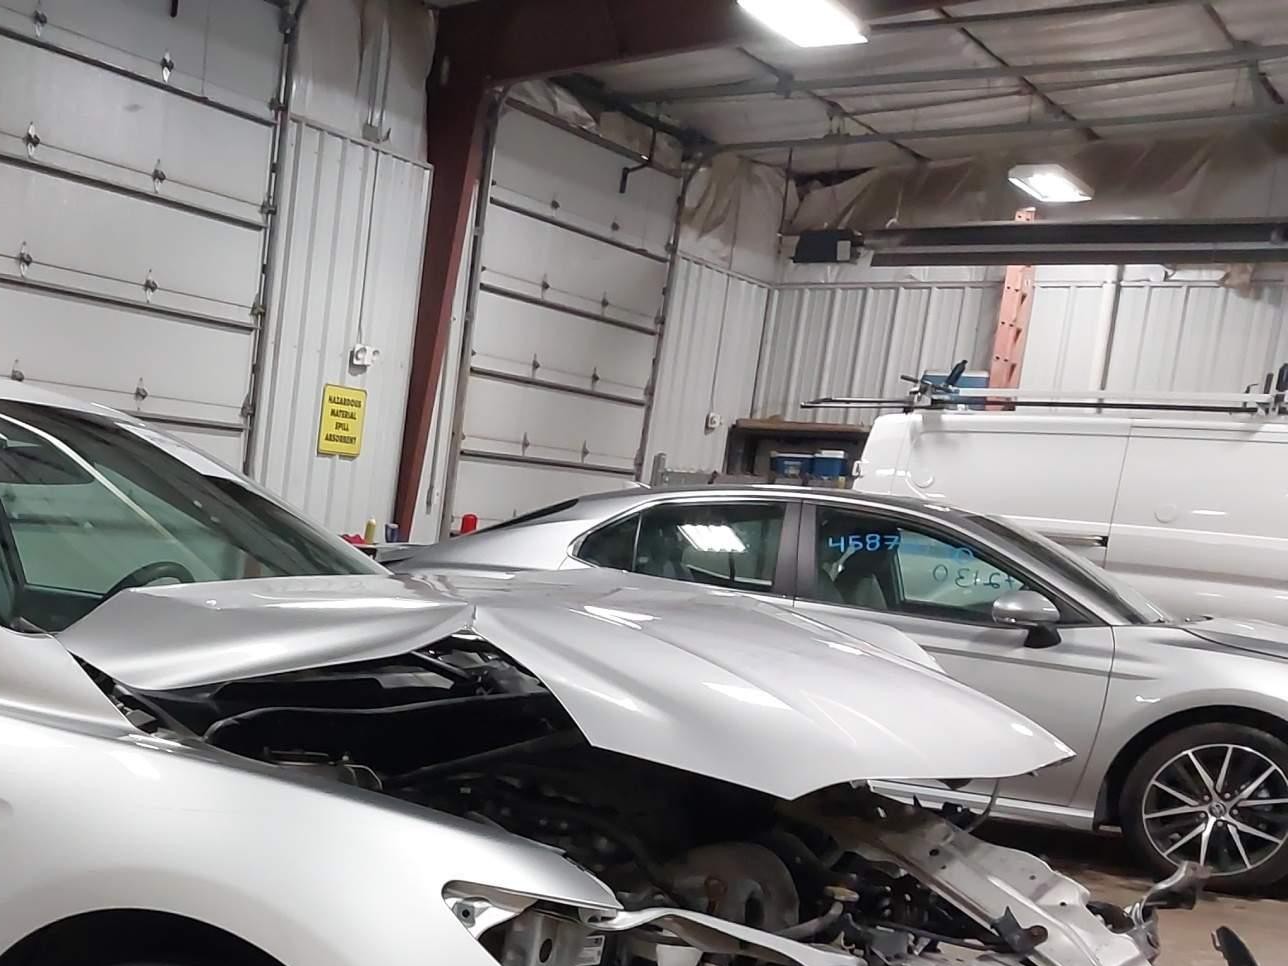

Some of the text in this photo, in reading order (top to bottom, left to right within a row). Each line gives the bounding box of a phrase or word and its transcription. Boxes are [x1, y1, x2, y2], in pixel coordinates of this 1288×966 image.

[328, 395, 361, 408] HAZARDOUS
[330, 408, 357, 420] MATERIAL
[335, 421, 349, 431] SPILL
[325, 433, 357, 445] ABSORBENT
